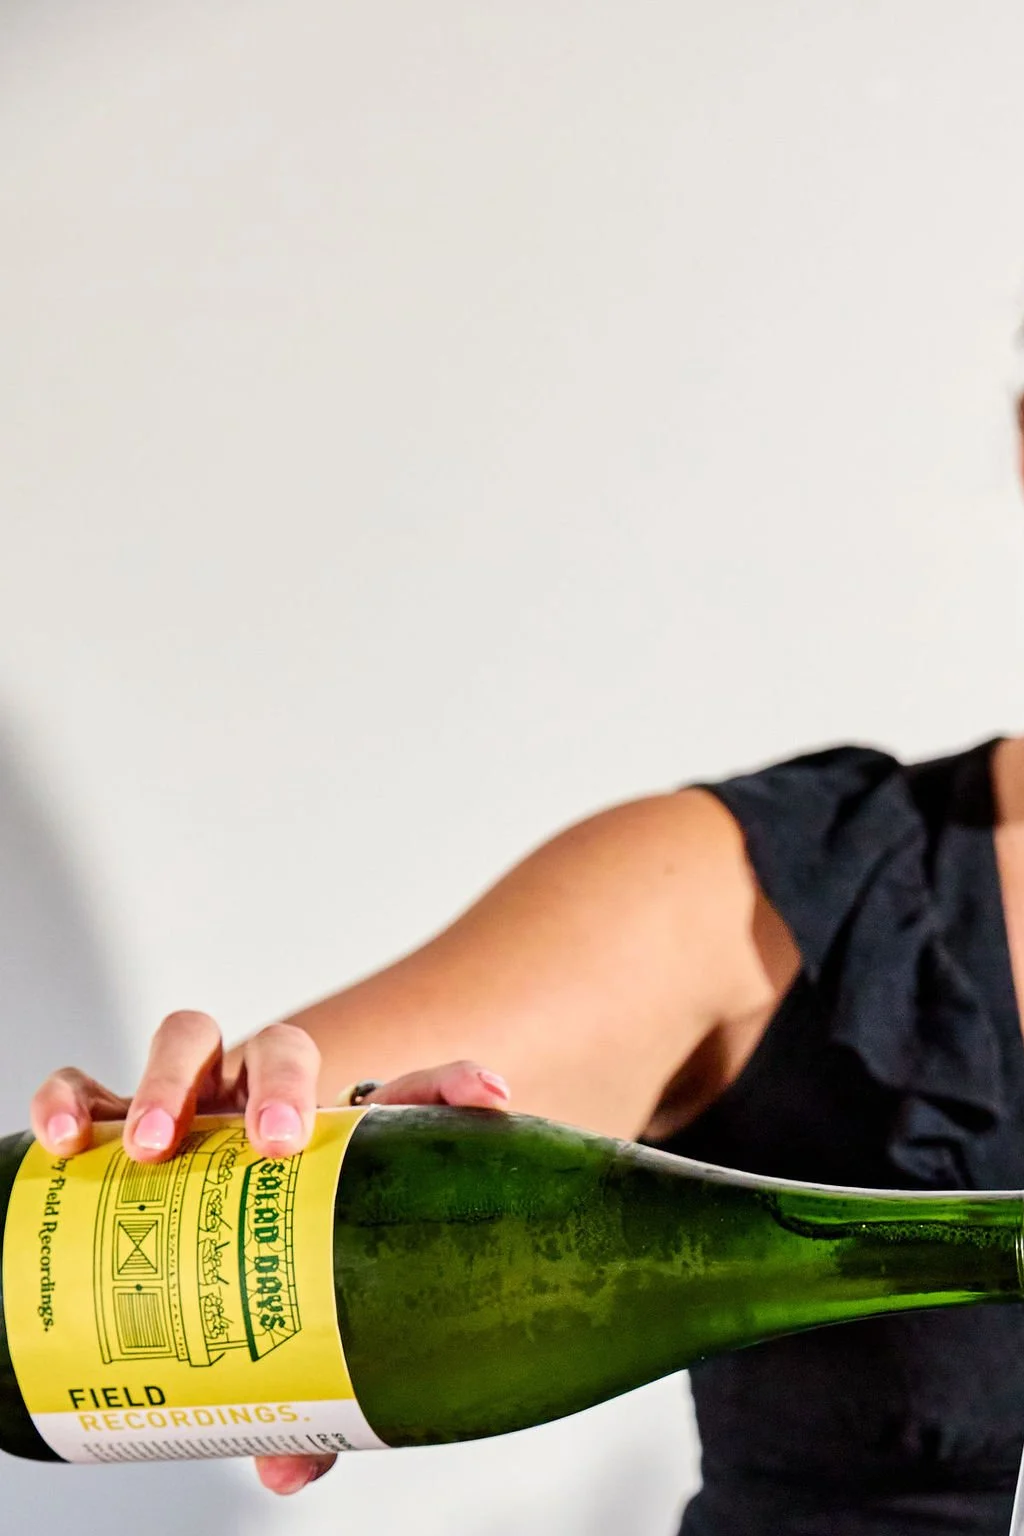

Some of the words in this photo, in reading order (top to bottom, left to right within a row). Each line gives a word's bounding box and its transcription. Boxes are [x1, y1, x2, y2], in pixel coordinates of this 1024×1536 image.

[44, 1176, 66, 1216] Field
[254, 1162, 285, 1243] SALAD
[37, 1221, 58, 1332] Recordings.
[254, 1255, 286, 1330] DAYS
[68, 1385, 167, 1410] FIELD
[78, 1404, 311, 1432] RECORDINGS.
